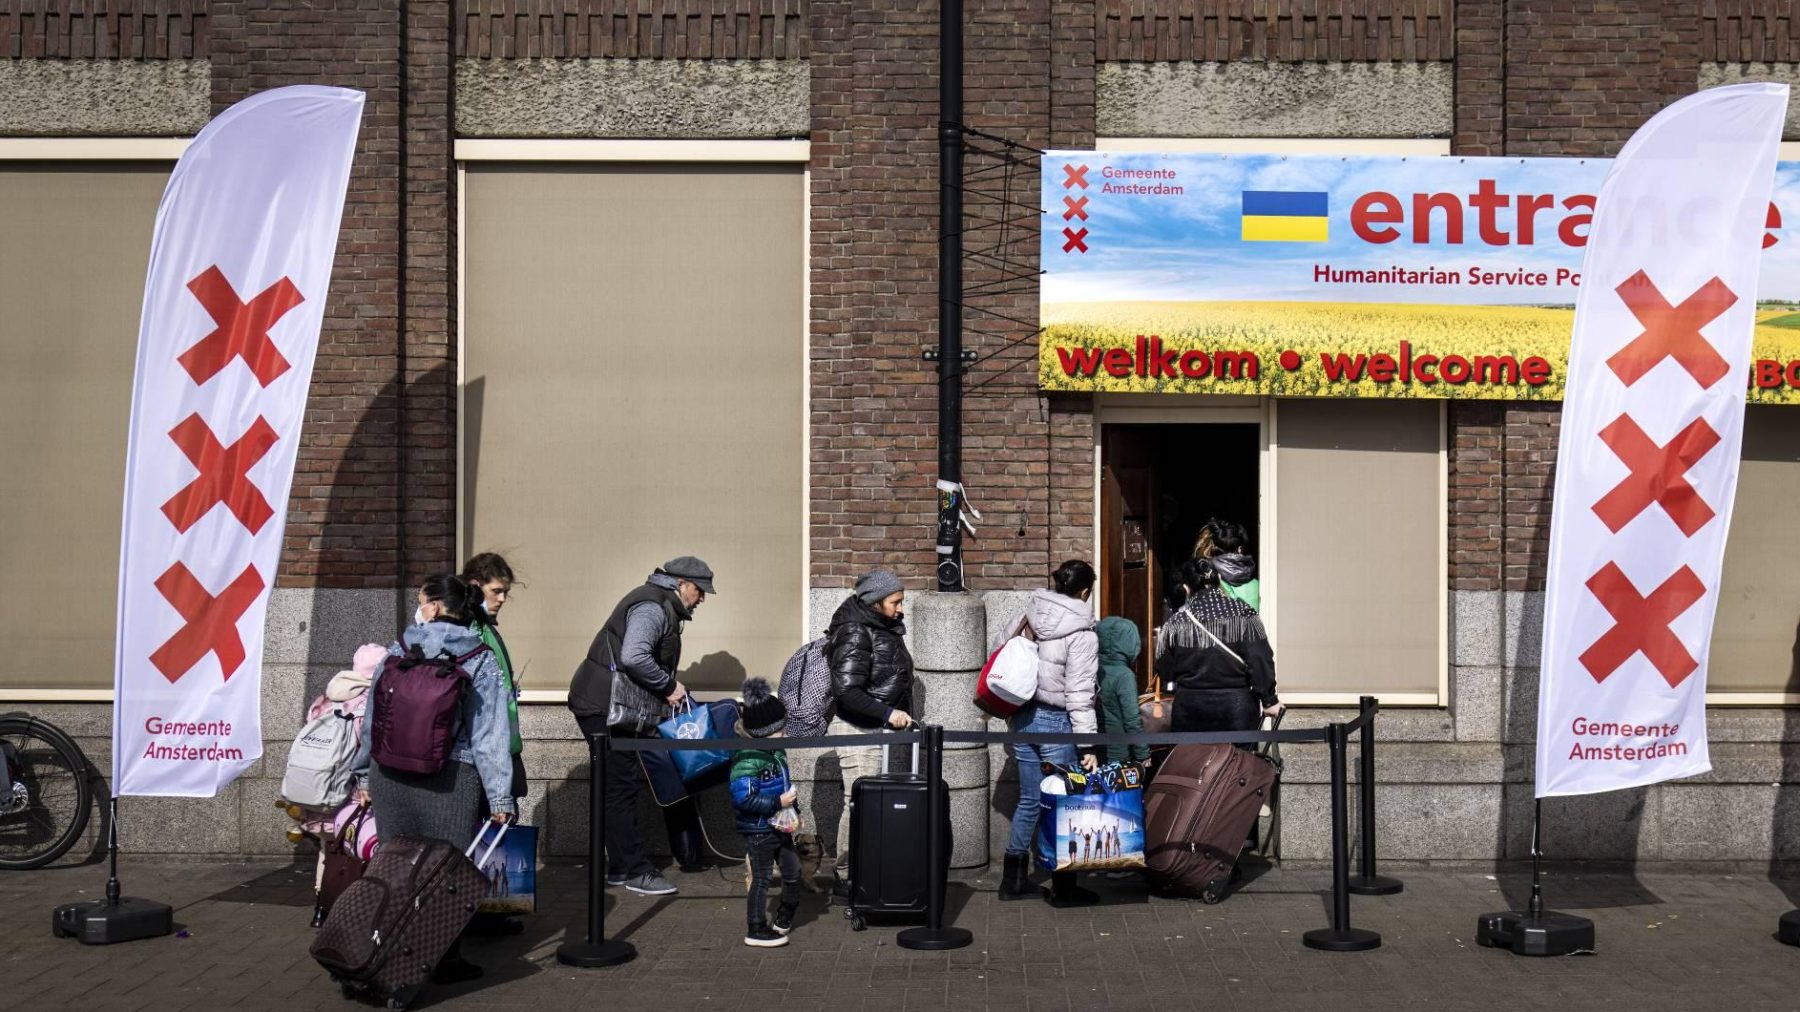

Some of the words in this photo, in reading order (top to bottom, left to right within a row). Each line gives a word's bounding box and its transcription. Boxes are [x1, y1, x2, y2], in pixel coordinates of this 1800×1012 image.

[1102, 166, 1176, 179] Gemeente
[1102, 182, 1184, 195] Amsterdam
[1314, 264, 1460, 284] Humanitarian
[1468, 266, 1548, 286] Service
[1056, 335, 1258, 379] welkom
[1320, 340, 1551, 385] welcome
[145, 716, 232, 736] Gemeente
[1572, 716, 1679, 737] Gemeente
[143, 741, 243, 761] Amsterdam
[1569, 741, 1687, 760] Amsterdam
